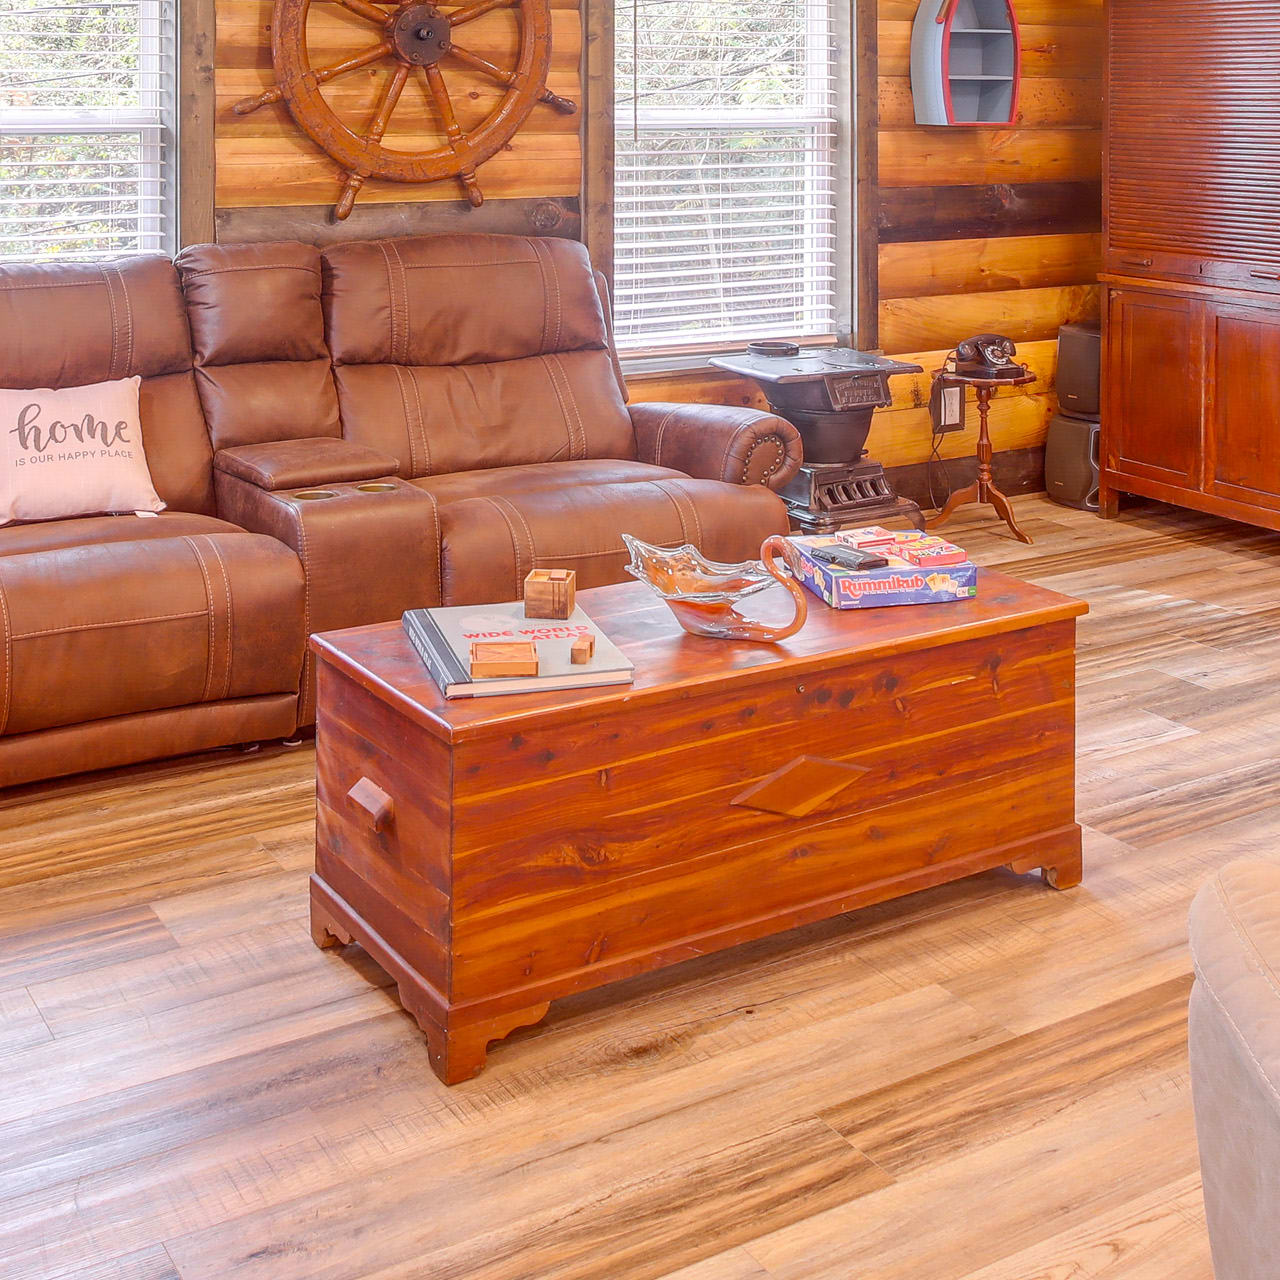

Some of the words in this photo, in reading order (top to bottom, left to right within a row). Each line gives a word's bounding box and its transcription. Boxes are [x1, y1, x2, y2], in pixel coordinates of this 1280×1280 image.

[9, 403, 130, 452] home
[15, 459, 26, 468] IS
[30, 455, 54, 465] OUR
[58, 451, 96, 461] HAPPY
[101, 449, 133, 459] PLACE
[840, 574, 926, 599] Rummikub
[463, 630, 514, 639] WIDE
[518, 625, 589, 636] WORLD
